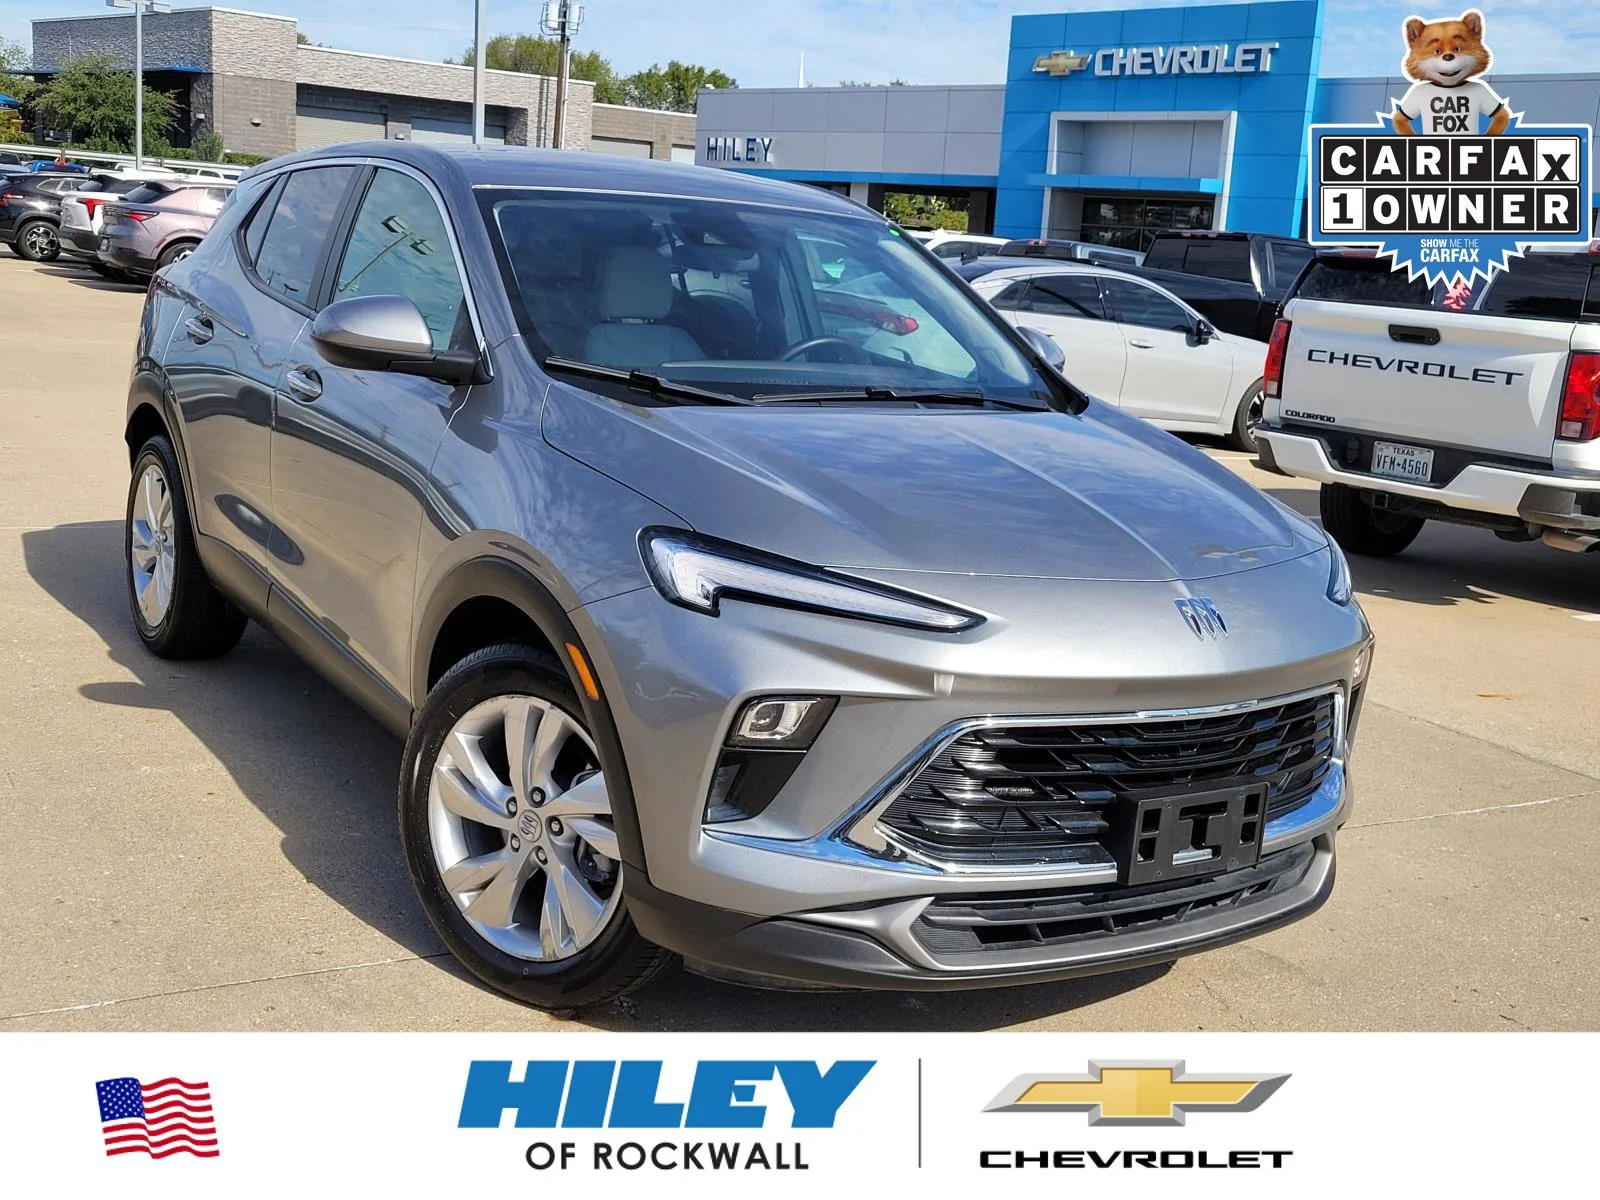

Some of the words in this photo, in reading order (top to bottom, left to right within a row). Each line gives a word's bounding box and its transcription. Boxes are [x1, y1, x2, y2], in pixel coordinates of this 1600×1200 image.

[1094, 42, 1279, 77] CHEVROLET
[706, 137, 773, 162] HILEY
[1307, 349, 1524, 386] CHEVROLET
[1285, 409, 1336, 423] COLORADO
[1393, 447, 1416, 457] TEXAS
